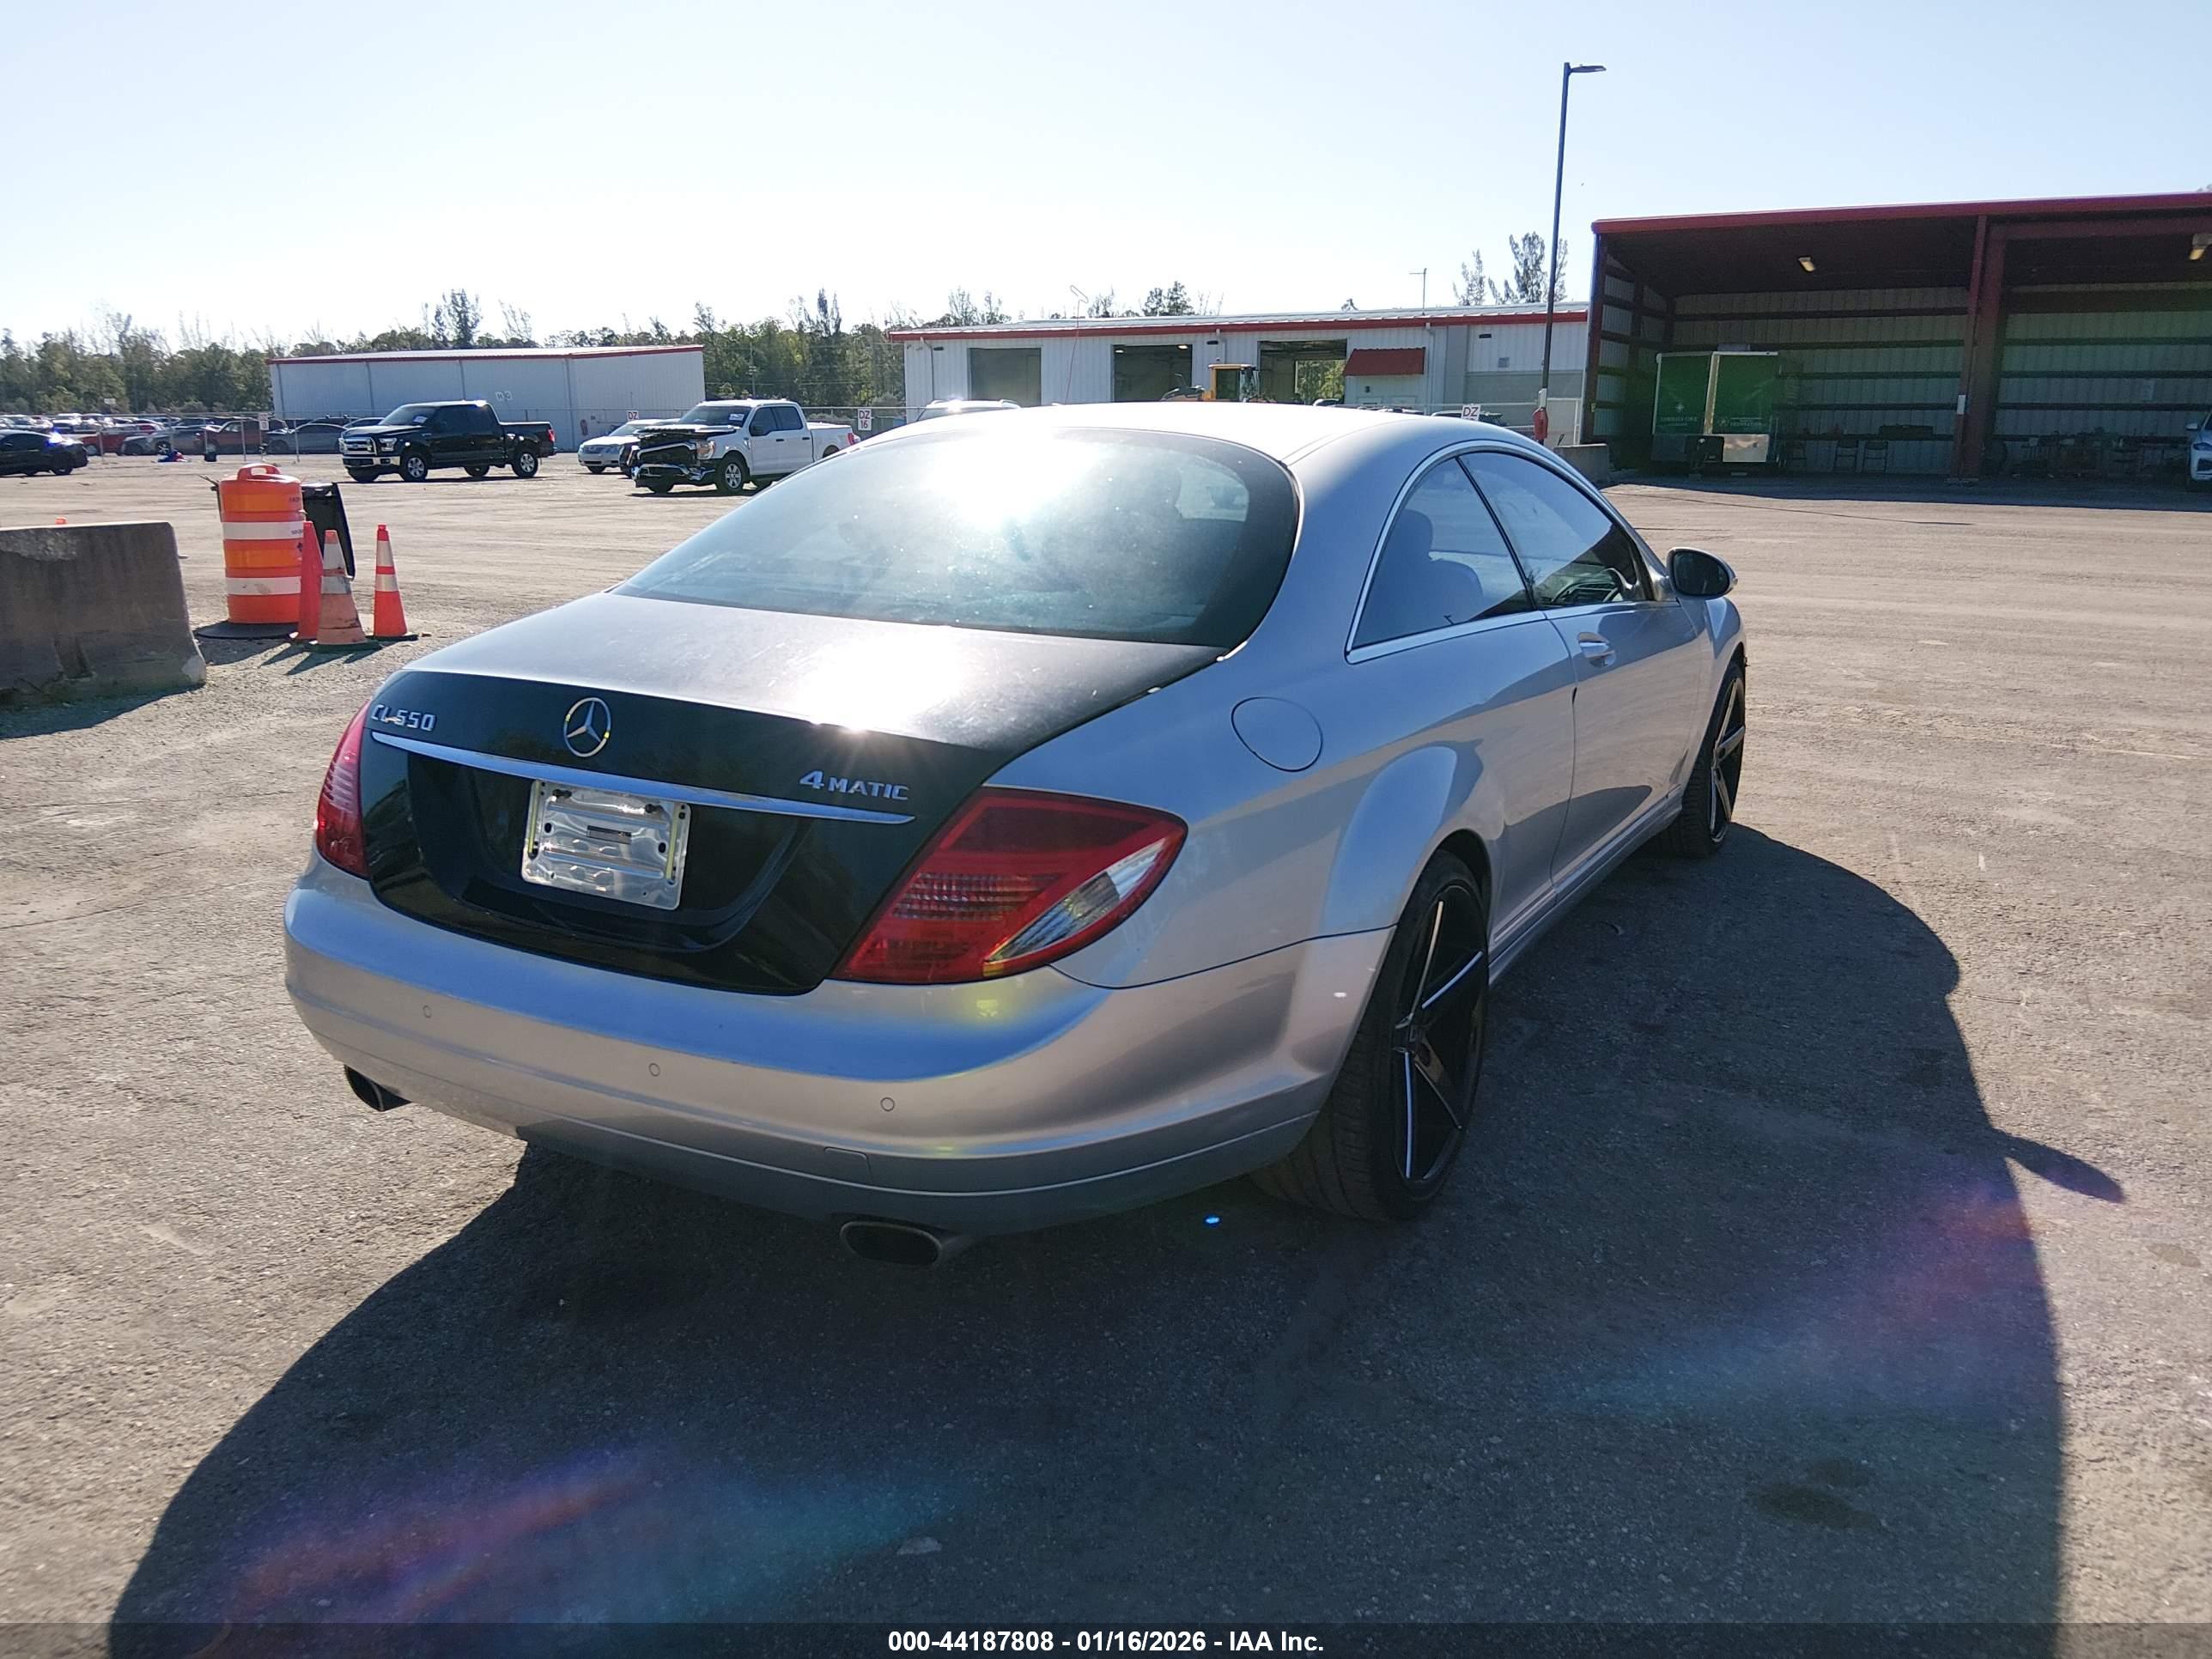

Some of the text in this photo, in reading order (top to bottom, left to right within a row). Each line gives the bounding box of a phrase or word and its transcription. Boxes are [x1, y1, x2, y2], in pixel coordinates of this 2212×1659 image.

[628, 411, 639, 420] DZ
[859, 410, 871, 419] DZ
[1463, 406, 1479, 416] DZ
[860, 420, 868, 428] 16
[370, 703, 436, 732] CL 550
